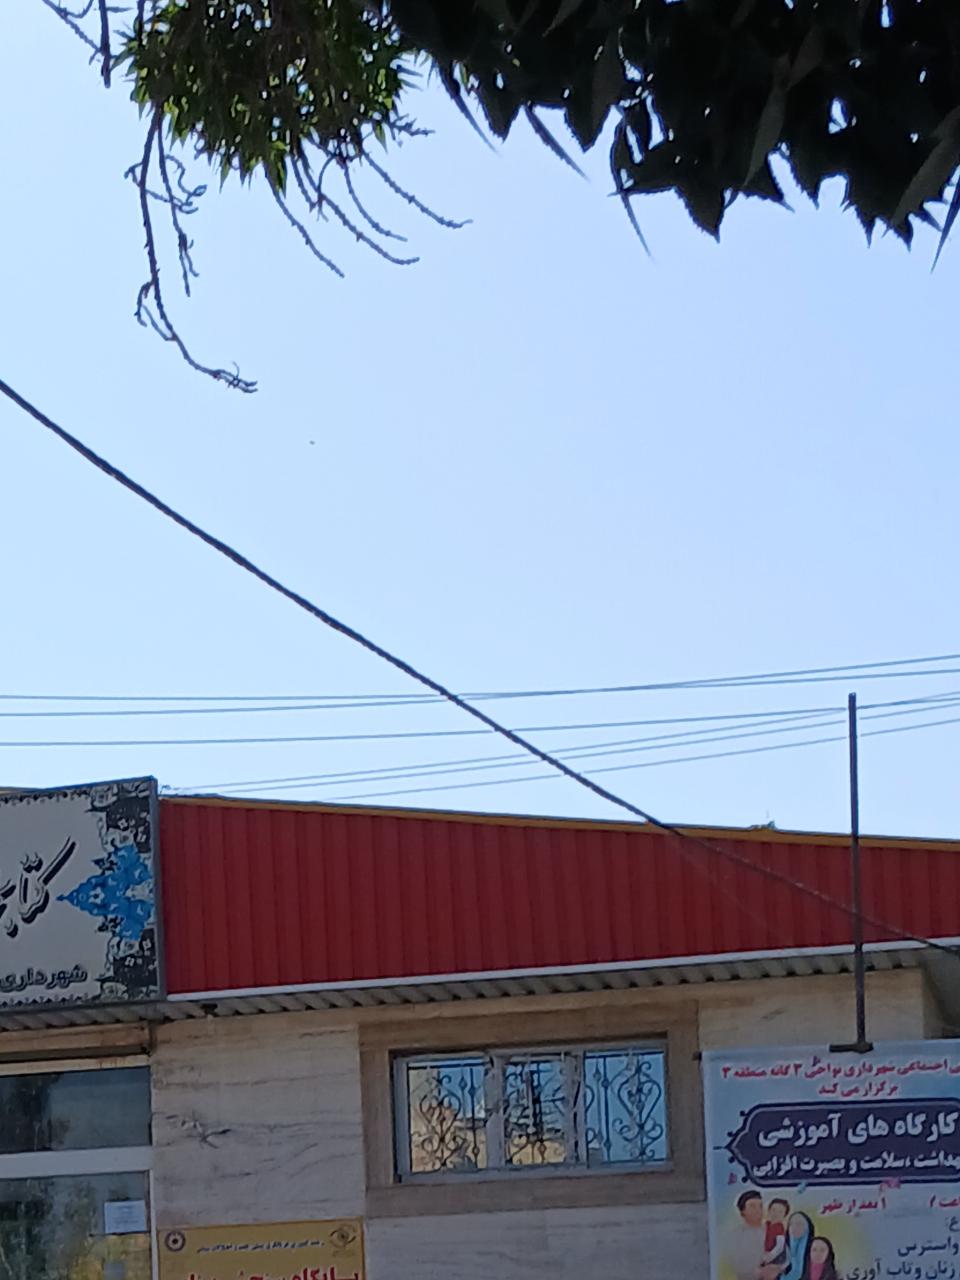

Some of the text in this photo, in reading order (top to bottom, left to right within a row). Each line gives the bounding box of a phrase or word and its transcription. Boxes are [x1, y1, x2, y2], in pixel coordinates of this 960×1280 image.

[733, 1066, 767, 1078] منطقه
[844, 1061, 896, 1078] شهرداری
[757, 1111, 842, 1148] آموزشی
[847, 1113, 890, 1145] های
[752, 1153, 798, 1178] افزایی
[799, 1157, 846, 1176] بصیرت
